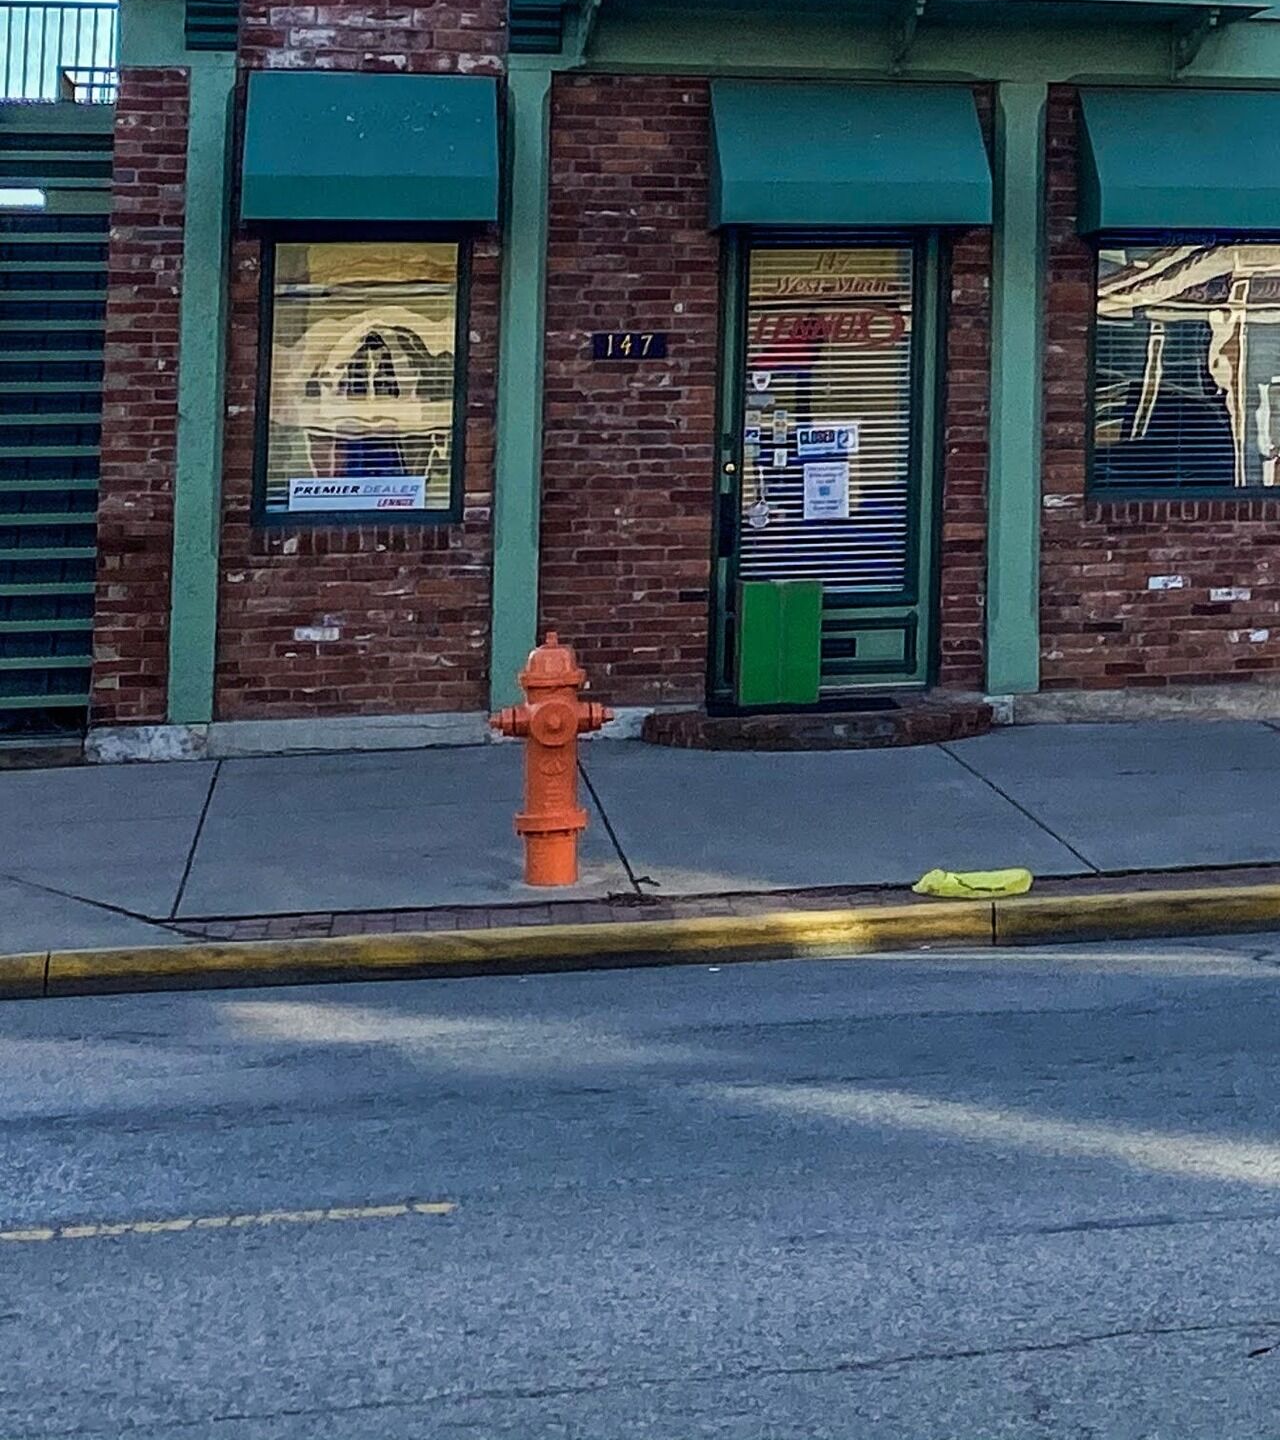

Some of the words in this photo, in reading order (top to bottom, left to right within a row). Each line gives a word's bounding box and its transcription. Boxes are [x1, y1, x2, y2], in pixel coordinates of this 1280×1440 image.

[814, 252, 850, 273] 147
[776, 275, 823, 294] West
[836, 275, 890, 294] Main
[606, 334, 654, 357] 147
[293, 485, 361, 495] PREMIER
[363, 484, 420, 494] DEALER
